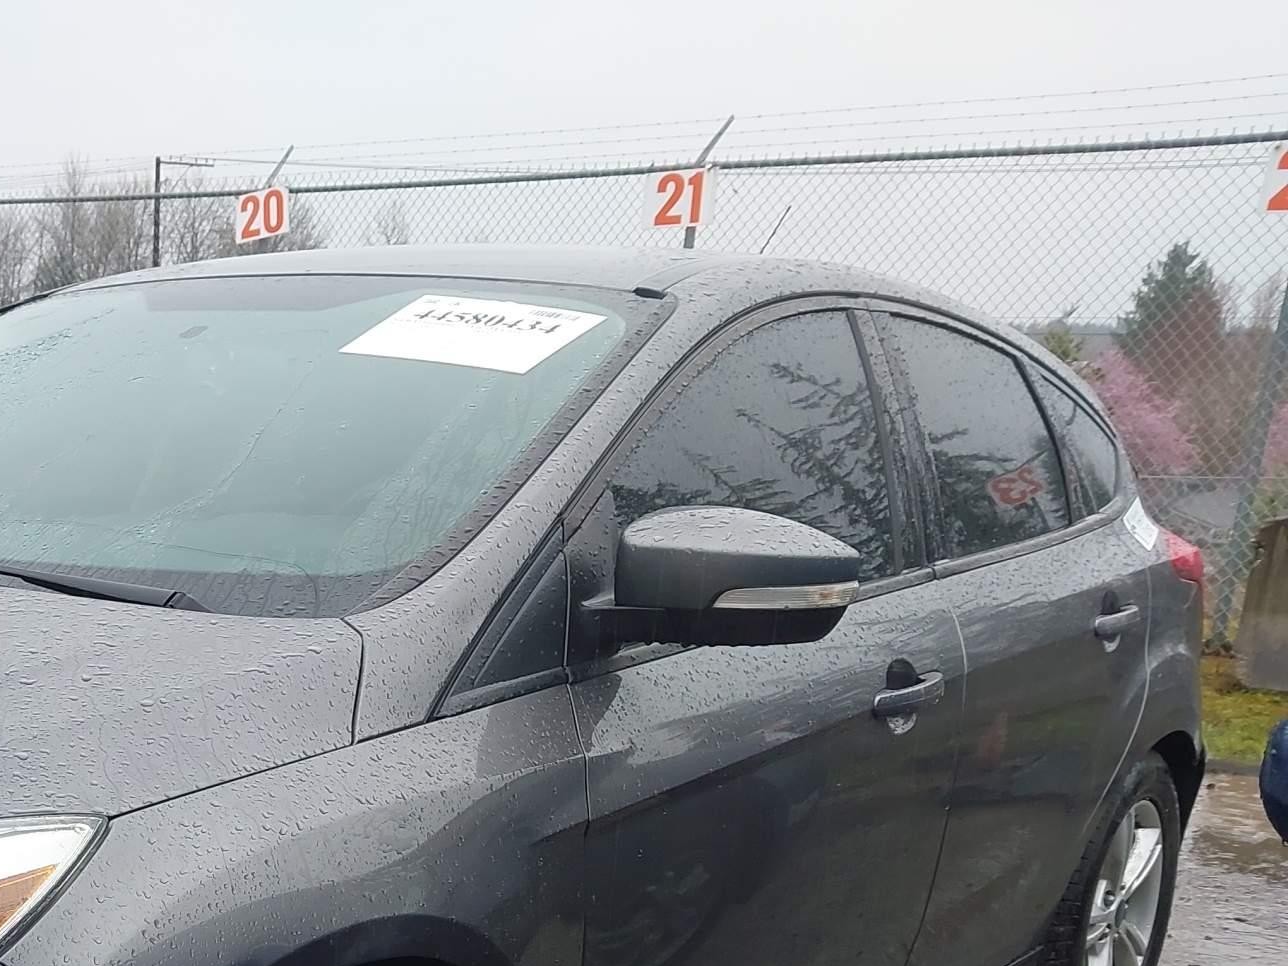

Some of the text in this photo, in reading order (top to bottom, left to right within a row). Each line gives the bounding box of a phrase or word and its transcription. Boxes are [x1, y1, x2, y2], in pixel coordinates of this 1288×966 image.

[241, 190, 283, 240] 20
[654, 171, 704, 226] 21
[413, 309, 562, 334] 44580434
